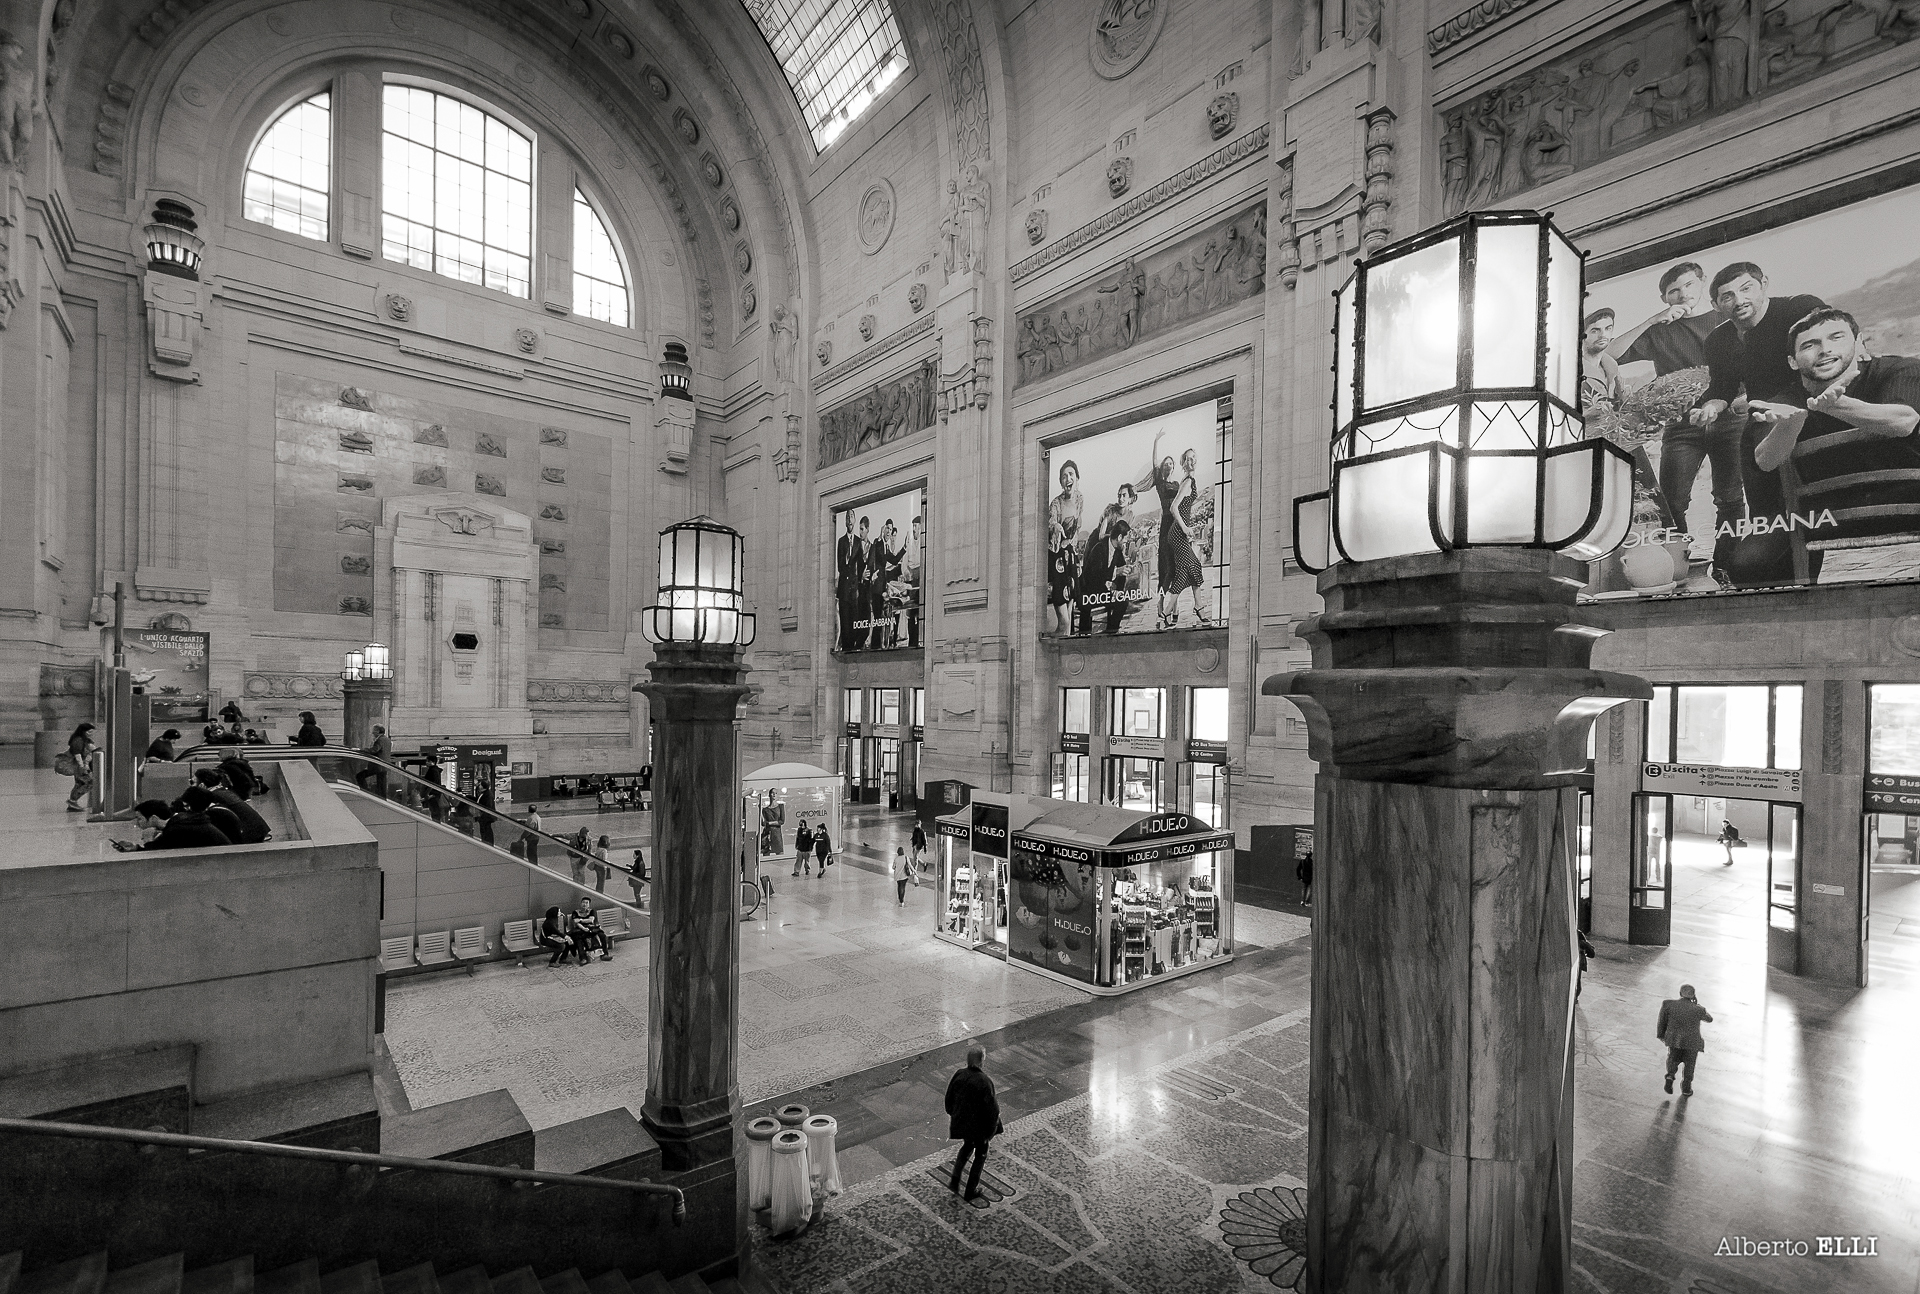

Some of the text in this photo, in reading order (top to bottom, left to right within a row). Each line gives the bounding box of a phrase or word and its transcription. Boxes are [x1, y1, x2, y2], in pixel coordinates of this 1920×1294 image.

[1621, 508, 1838, 548] OLCE & GABBANA
[1082, 592, 1111, 606] DOLCE
[1115, 586, 1166, 602] GABBANA
[852, 619, 869, 629] DOLCE
[871, 616, 897, 628] GABBANA
[140, 633, 204, 643] L'UNICO ACQUARIO
[151, 641, 204, 650] VISIBILE DALLO
[1663, 765, 1698, 774] Uscita
[1899, 779, 1920, 788] Bus
[795, 809, 828, 818] CAMOMILLA
[941, 826, 968, 837] H.DUE.O
[975, 825, 1006, 838] H.DUE.O
[1140, 816, 1188, 835] H.DUE.O
[1014, 839, 1046, 853] H.DUE.O
[1166, 844, 1195, 856] H.DUE.O
[1201, 840, 1229, 851] H.DUE.O
[1053, 845, 1088, 861] H.DUE.O
[1127, 850, 1159, 863] H.DUE.O
[1054, 917, 1092, 936] H.DUE.O
